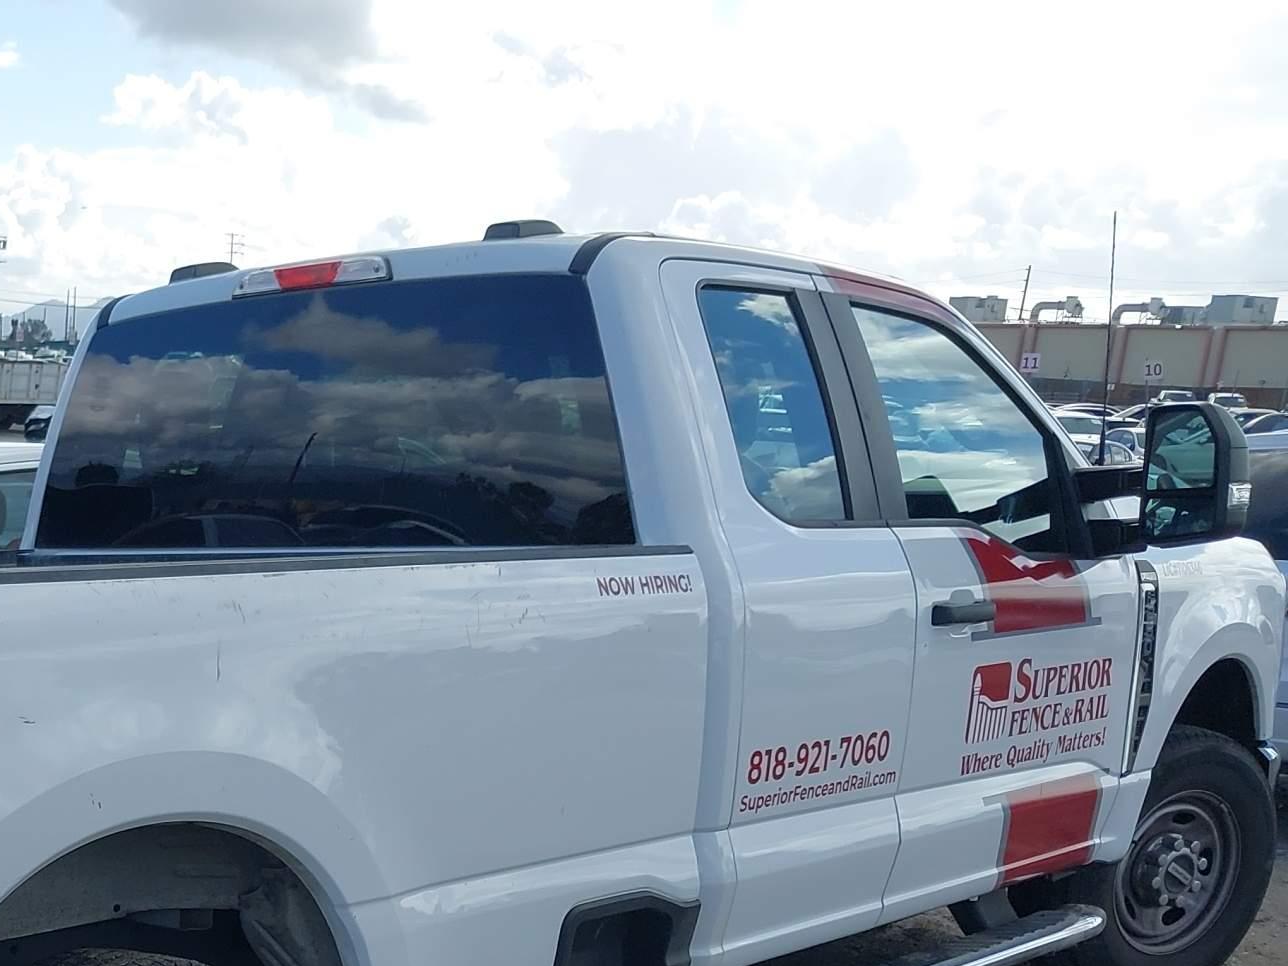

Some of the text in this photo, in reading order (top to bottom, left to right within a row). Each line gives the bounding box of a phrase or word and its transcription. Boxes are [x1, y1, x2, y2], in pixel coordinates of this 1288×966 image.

[1022, 357, 1040, 370] 11
[1144, 363, 1162, 377] 10
[596, 574, 693, 597] NOW HIRING!
[1013, 658, 1113, 703] SUPERIOR
[747, 730, 891, 785] 818-921-7060
[960, 727, 1107, 776] Where Quality Matters!
[739, 771, 897, 814] SuperiorFenceandRail.com
